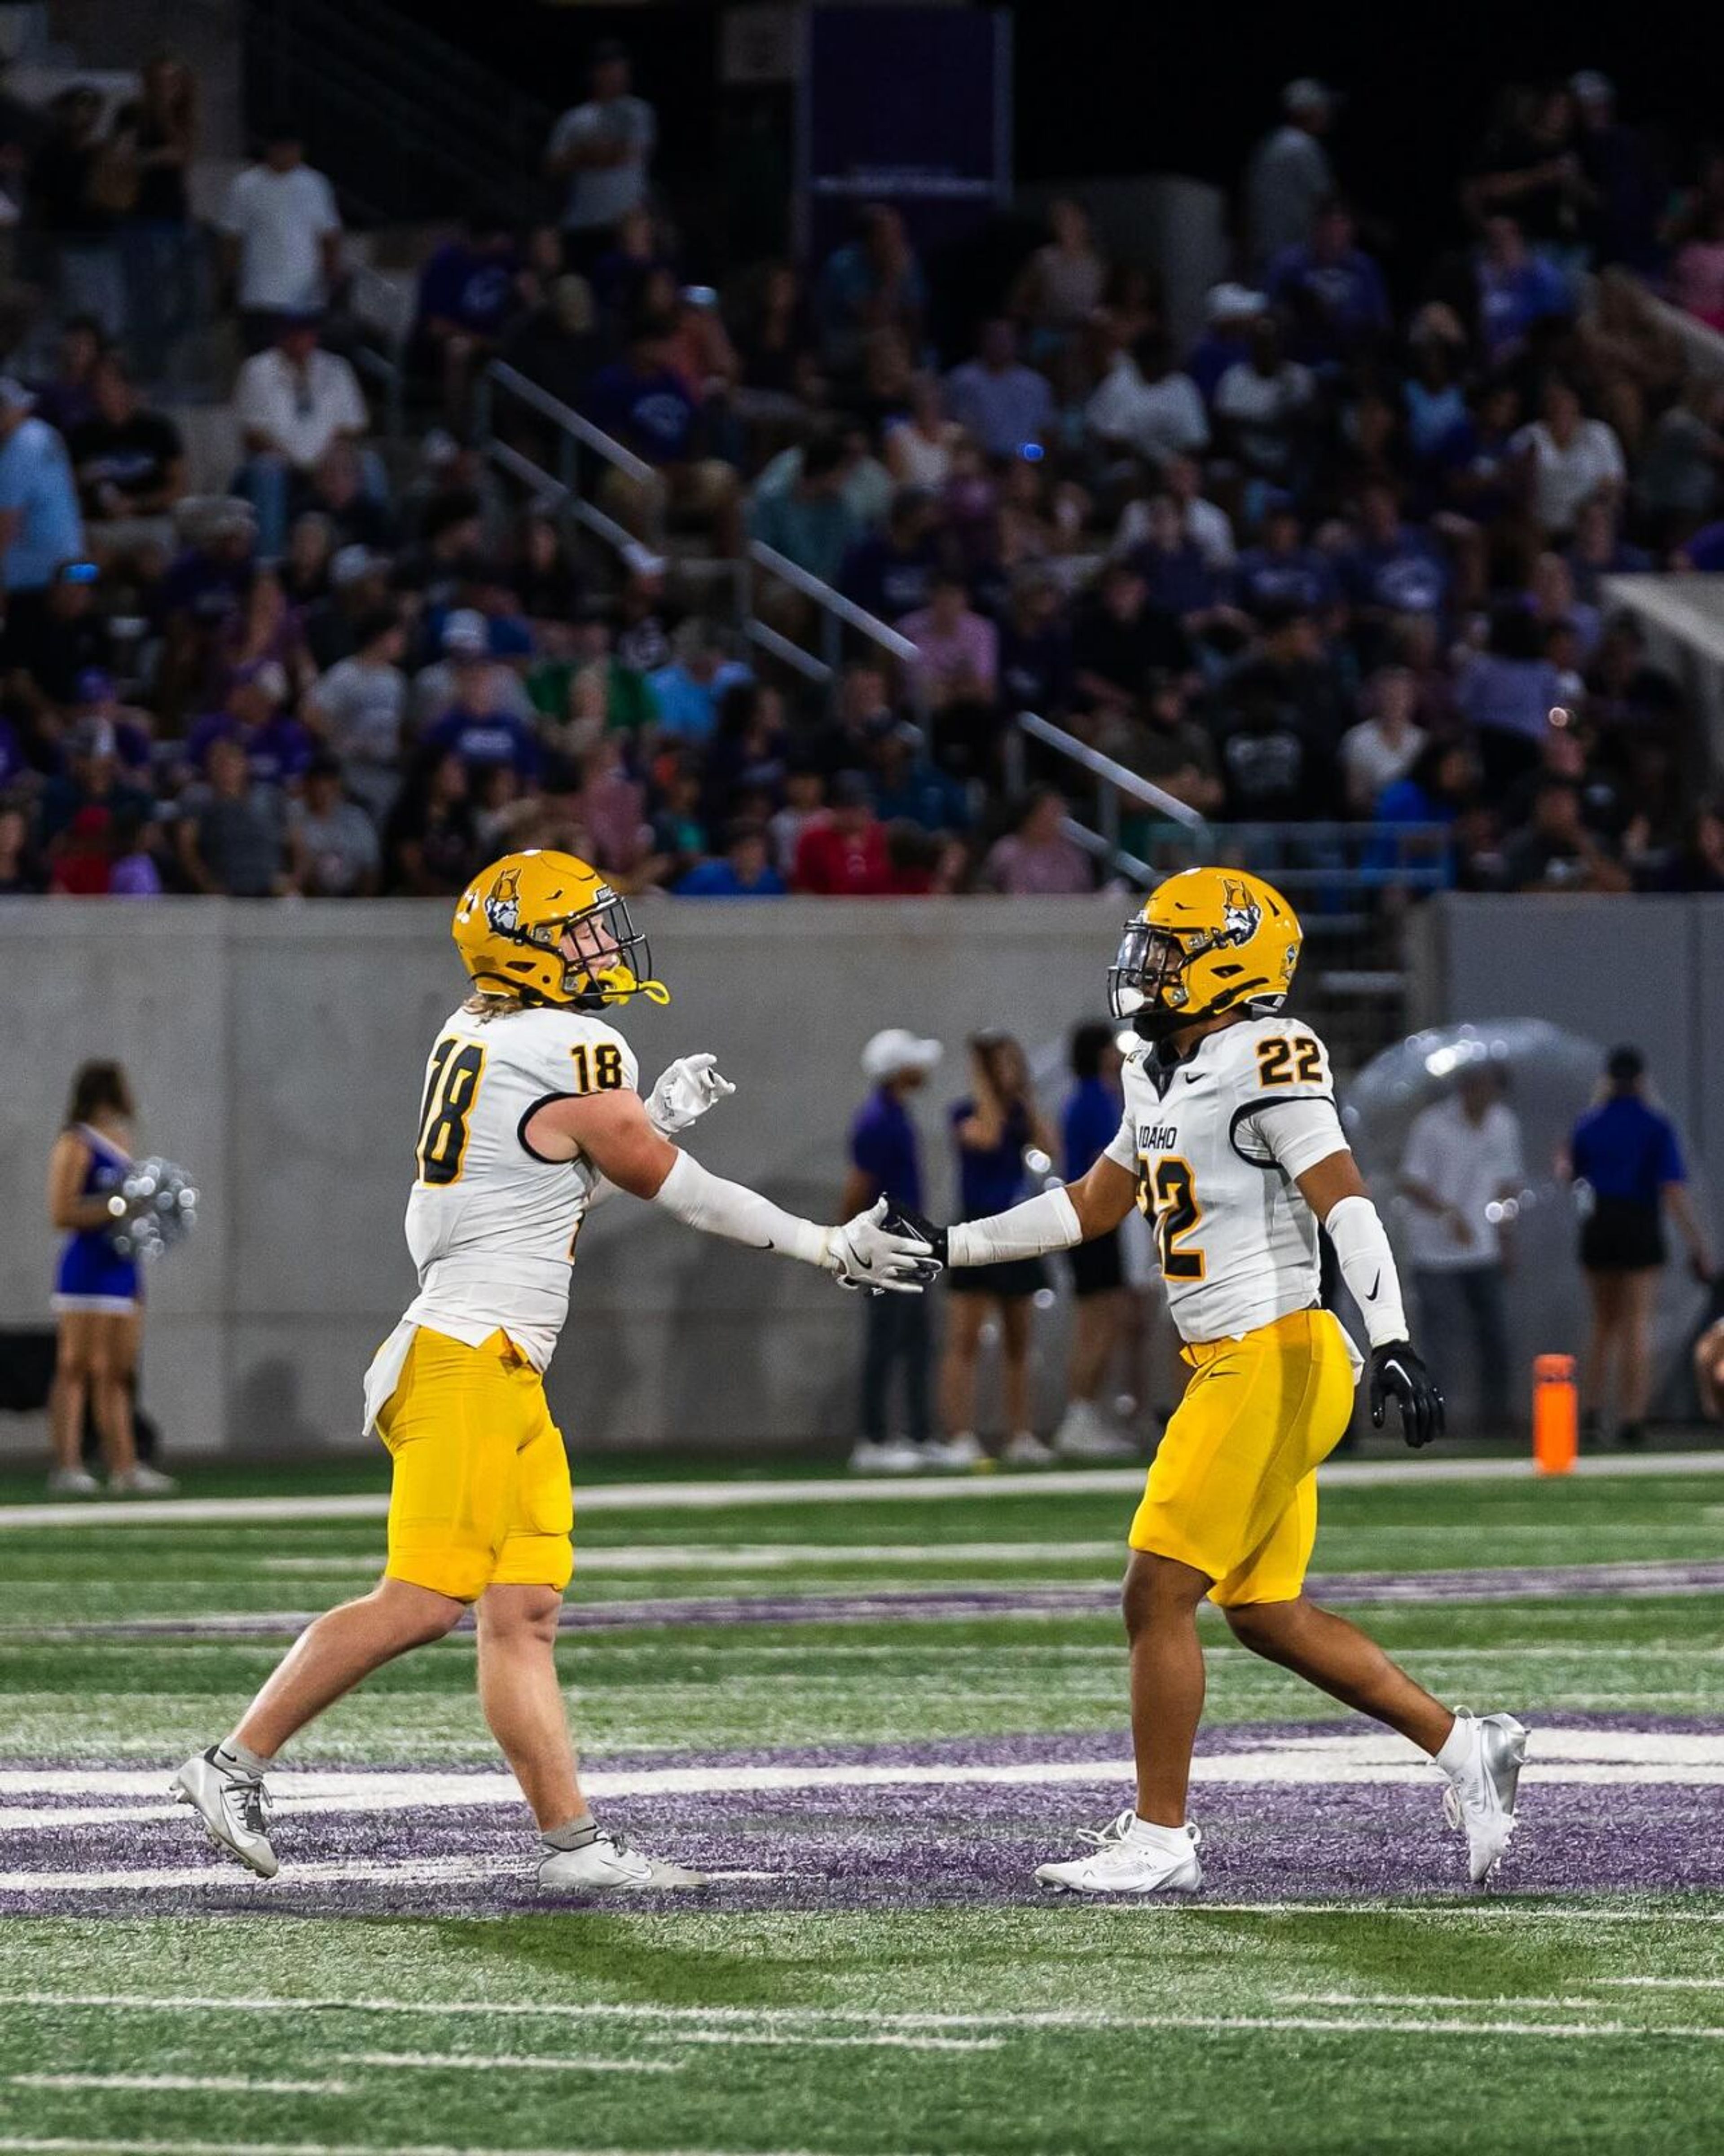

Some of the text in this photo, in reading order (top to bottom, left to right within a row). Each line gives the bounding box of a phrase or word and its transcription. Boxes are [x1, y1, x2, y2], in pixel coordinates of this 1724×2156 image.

[570, 1044, 623, 1093] 18
[1256, 1036, 1323, 1087] 22
[416, 1035, 488, 1188] 18
[1139, 1125, 1177, 1149] IDAHO
